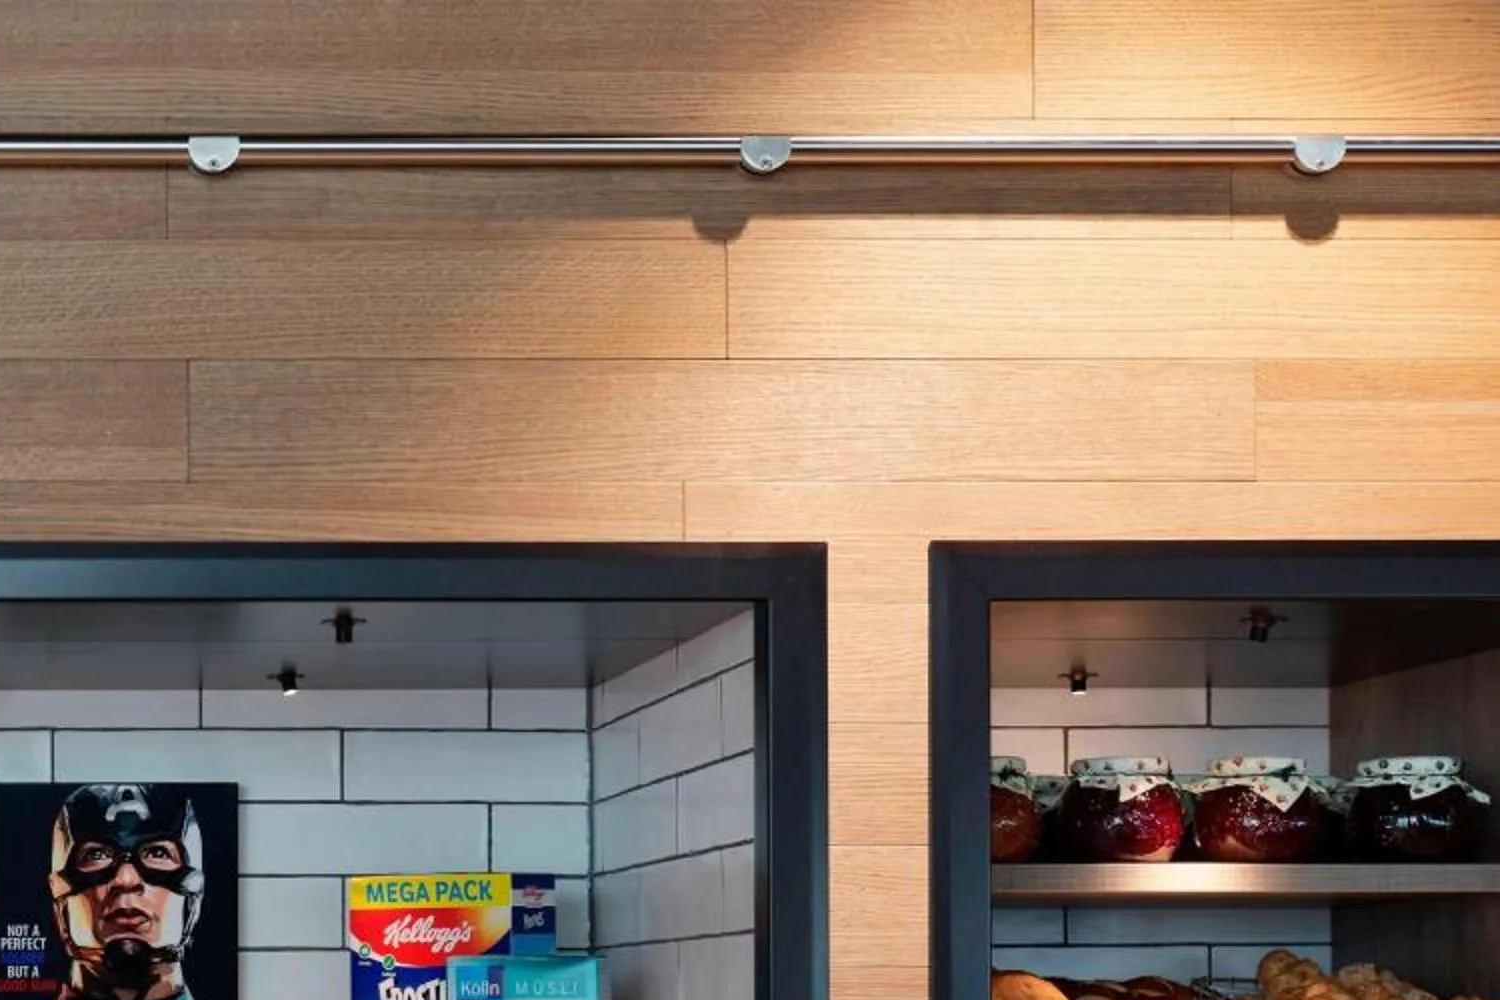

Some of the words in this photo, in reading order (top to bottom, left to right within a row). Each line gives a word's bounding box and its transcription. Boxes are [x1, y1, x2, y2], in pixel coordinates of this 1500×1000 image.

[366, 881, 430, 904] MEGA
[436, 879, 493, 902] PACK
[7, 924, 29, 937] NOT
[32, 924, 40, 937] A
[383, 914, 474, 954] Kellogg's
[0, 937, 47, 950] PERFECT
[7, 965, 29, 978] BUT
[32, 965, 40, 978] A
